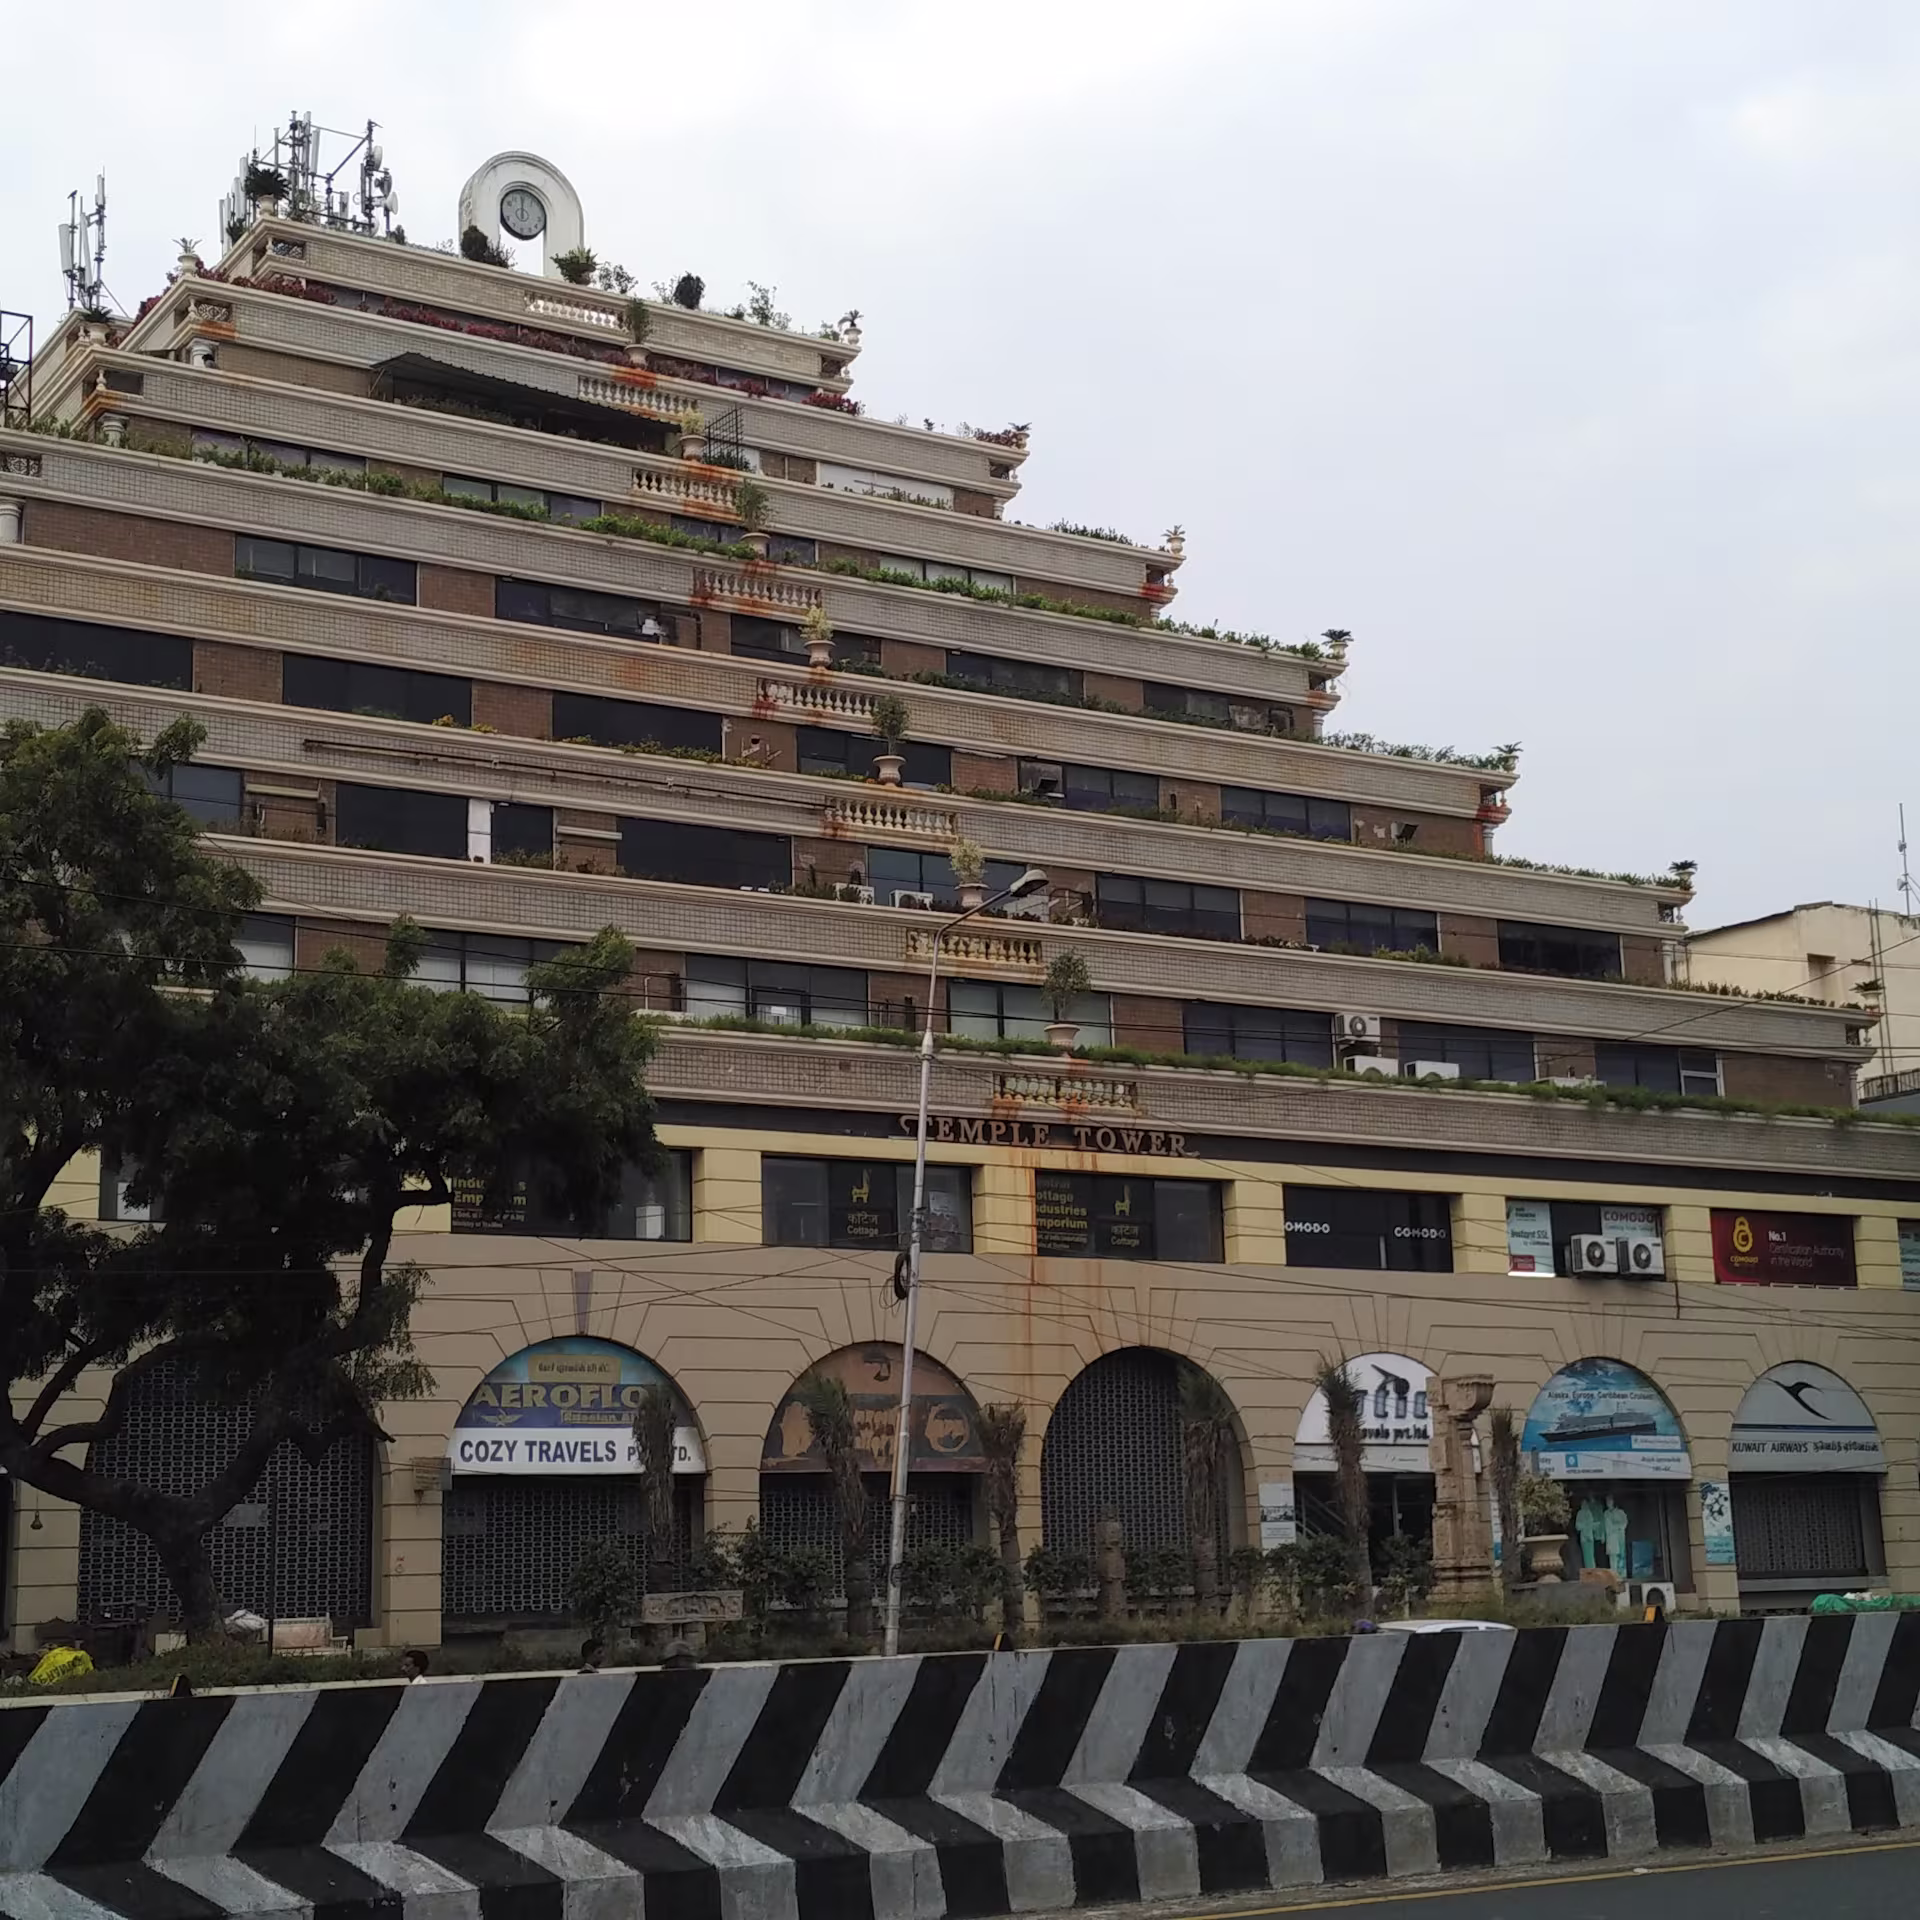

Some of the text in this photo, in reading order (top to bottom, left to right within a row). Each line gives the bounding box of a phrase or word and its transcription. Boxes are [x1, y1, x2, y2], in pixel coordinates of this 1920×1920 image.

[1073, 1126, 1200, 1158] TOWER
[1037, 1190, 1074, 1204] ottage
[1037, 1204, 1088, 1216] dustries
[1037, 1217, 1088, 1230] mporium
[1604, 1211, 1655, 1223] COMODO
[847, 1225, 879, 1238] Cottage
[1285, 1220, 1331, 1234] OMODO
[1393, 1226, 1447, 1240] COMODO
[1768, 1230, 1787, 1242] No.1
[473, 1384, 650, 1408] AEROFLO
[460, 1440, 518, 1462] COZY
[525, 1440, 617, 1462] TRAVELS
[1732, 1442, 1809, 1453] KUWAIT AIRWAYS
